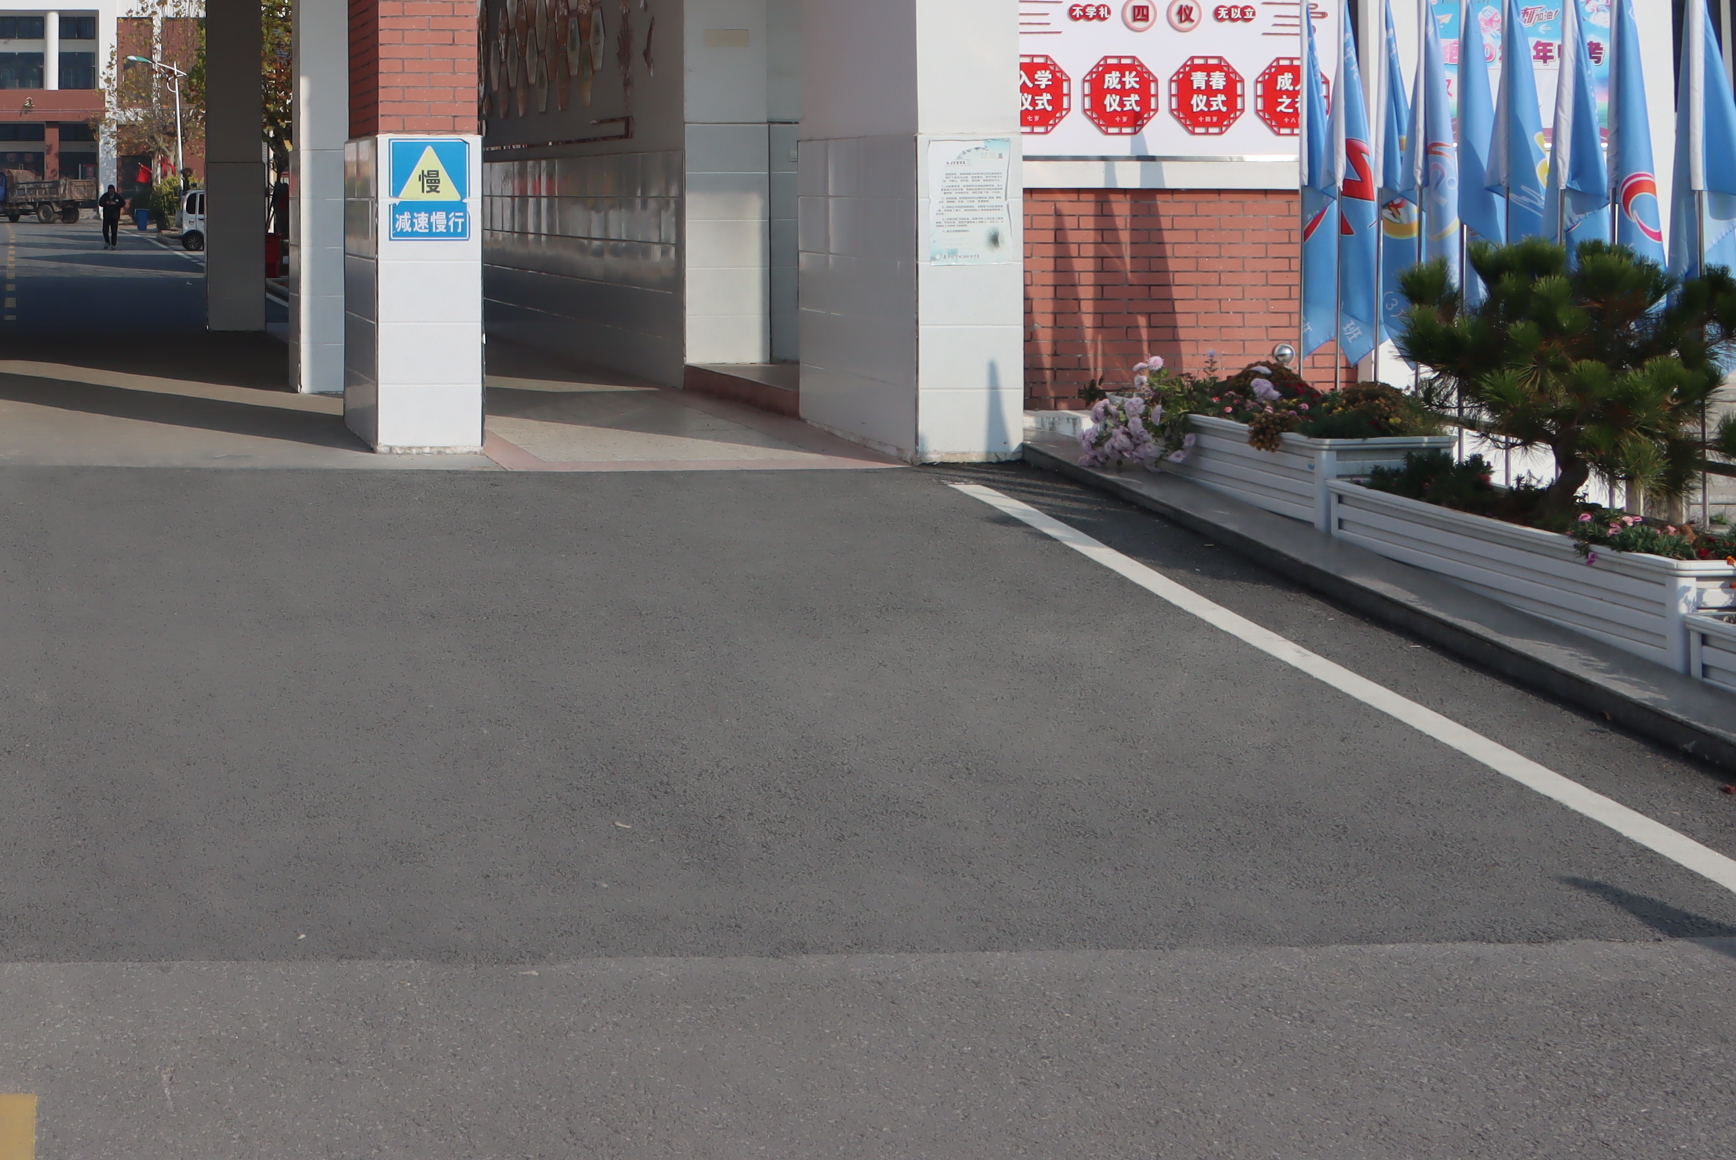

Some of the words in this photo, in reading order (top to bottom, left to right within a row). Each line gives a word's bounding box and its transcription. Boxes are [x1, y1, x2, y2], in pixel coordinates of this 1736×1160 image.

[1071, 6, 1111, 19] 不学礼
[1132, 4, 1150, 23] 四
[1177, 4, 1195, 24] 仪
[1217, 7, 1256, 19] 无以立
[1103, 71, 1140, 90] 成长
[1190, 71, 1227, 90] 青春
[1103, 94, 1141, 112] 仪式
[1190, 94, 1228, 112] 仪式
[418, 169, 441, 194] 慢
[395, 211, 465, 233] 减速慢行
